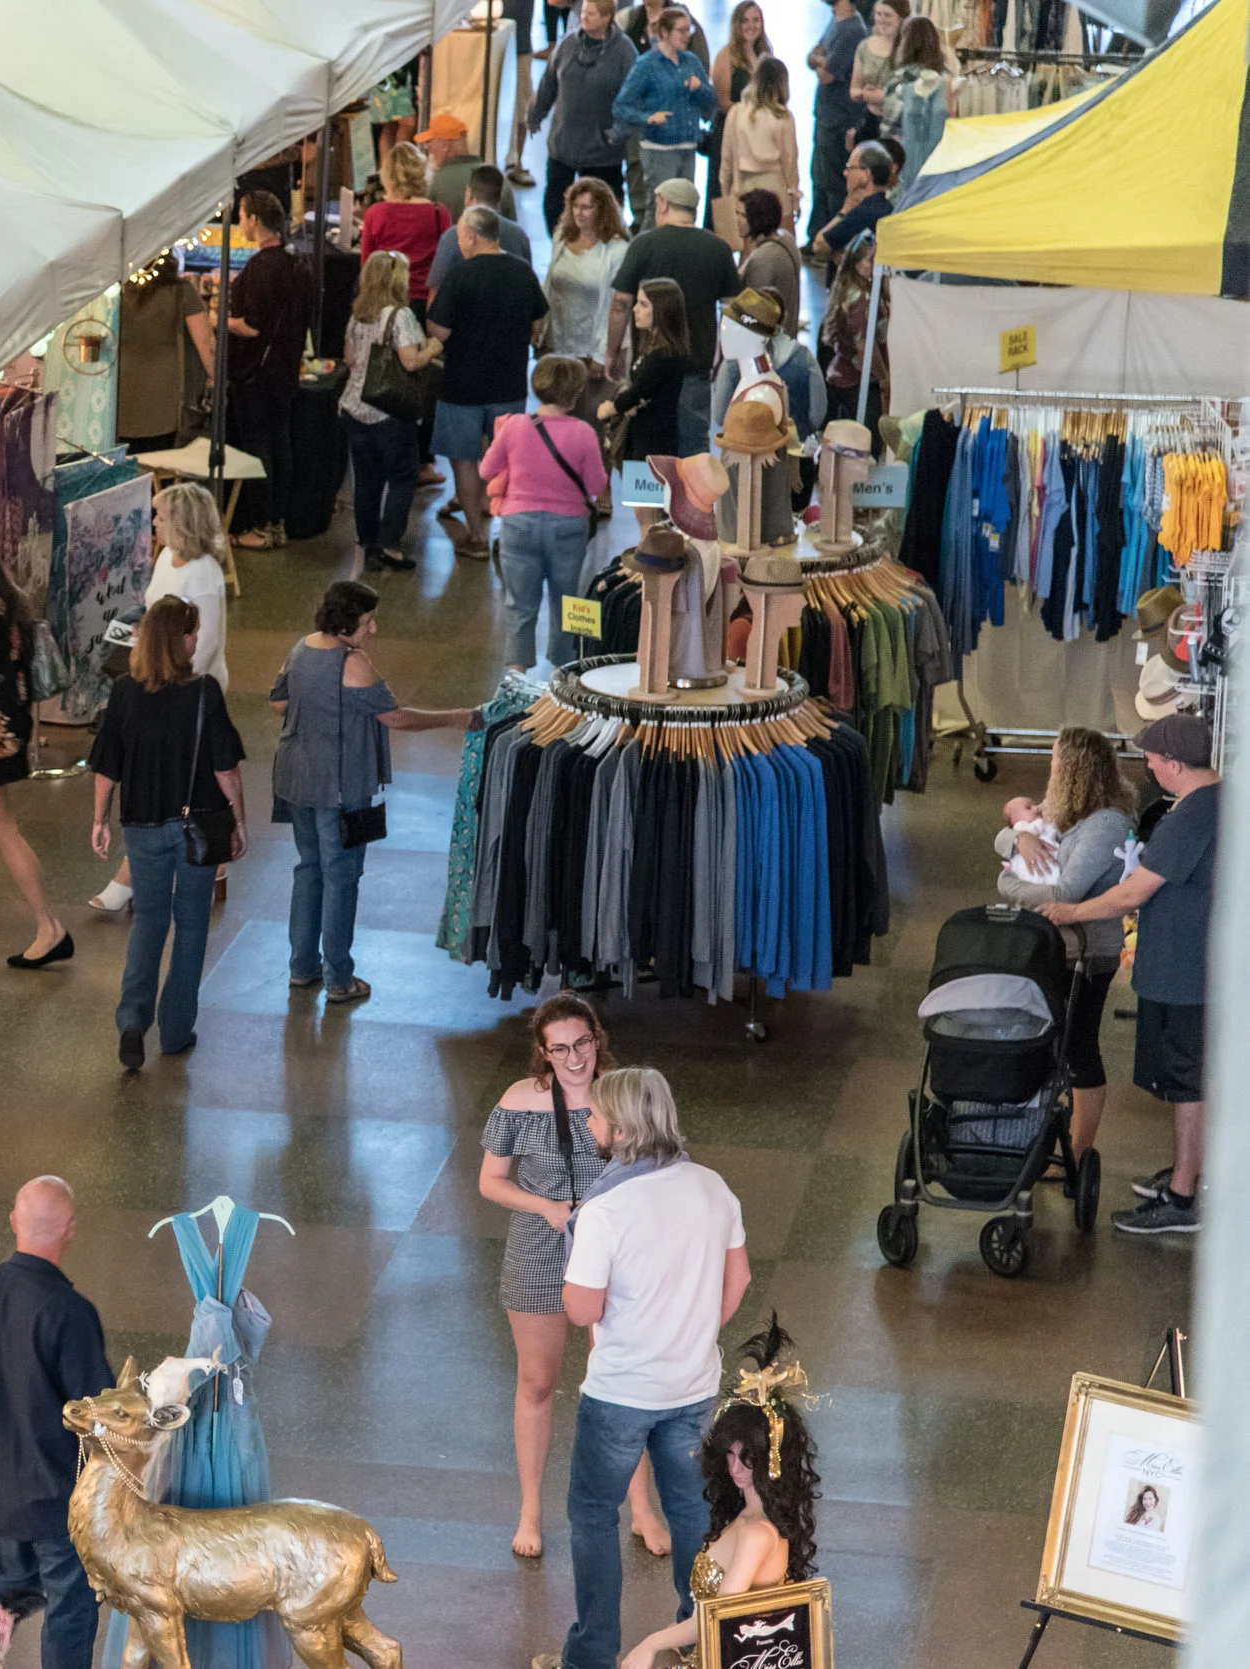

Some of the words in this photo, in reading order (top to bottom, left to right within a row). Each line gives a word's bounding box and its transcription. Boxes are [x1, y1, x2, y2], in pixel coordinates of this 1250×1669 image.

[634, 478, 664, 492] Men
[853, 482, 894, 495] Men's
[567, 612, 596, 625] Clothes
[1141, 1468, 1164, 1479] NYC
[777, 1639, 805, 1669] Ellie
